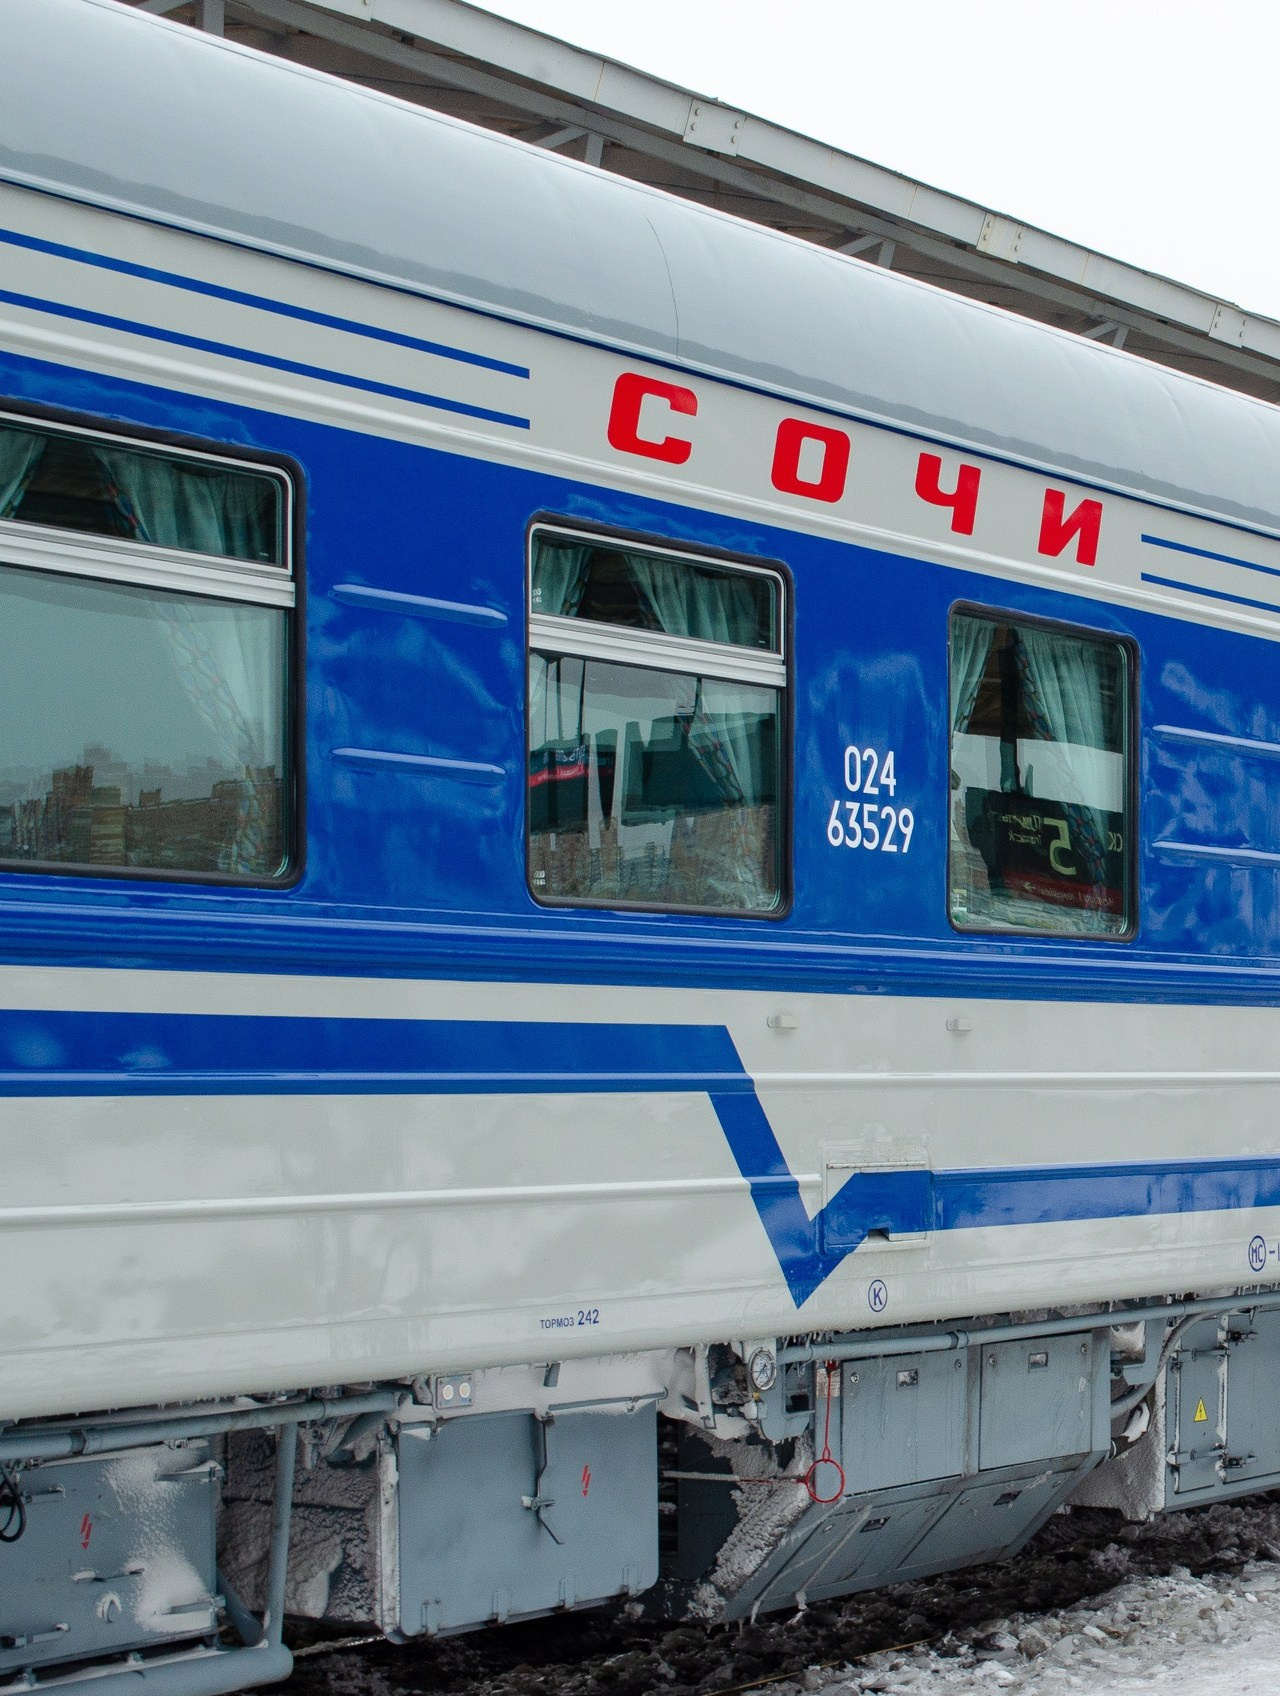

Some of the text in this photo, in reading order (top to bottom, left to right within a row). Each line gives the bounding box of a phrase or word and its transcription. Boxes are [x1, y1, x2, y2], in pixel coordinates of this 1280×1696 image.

[607, 371, 1104, 567] СОЧИ
[844, 745, 897, 797] 024
[827, 799, 915, 854] 63529
[540, 1308, 600, 1329] ТОРМОЗ 242
